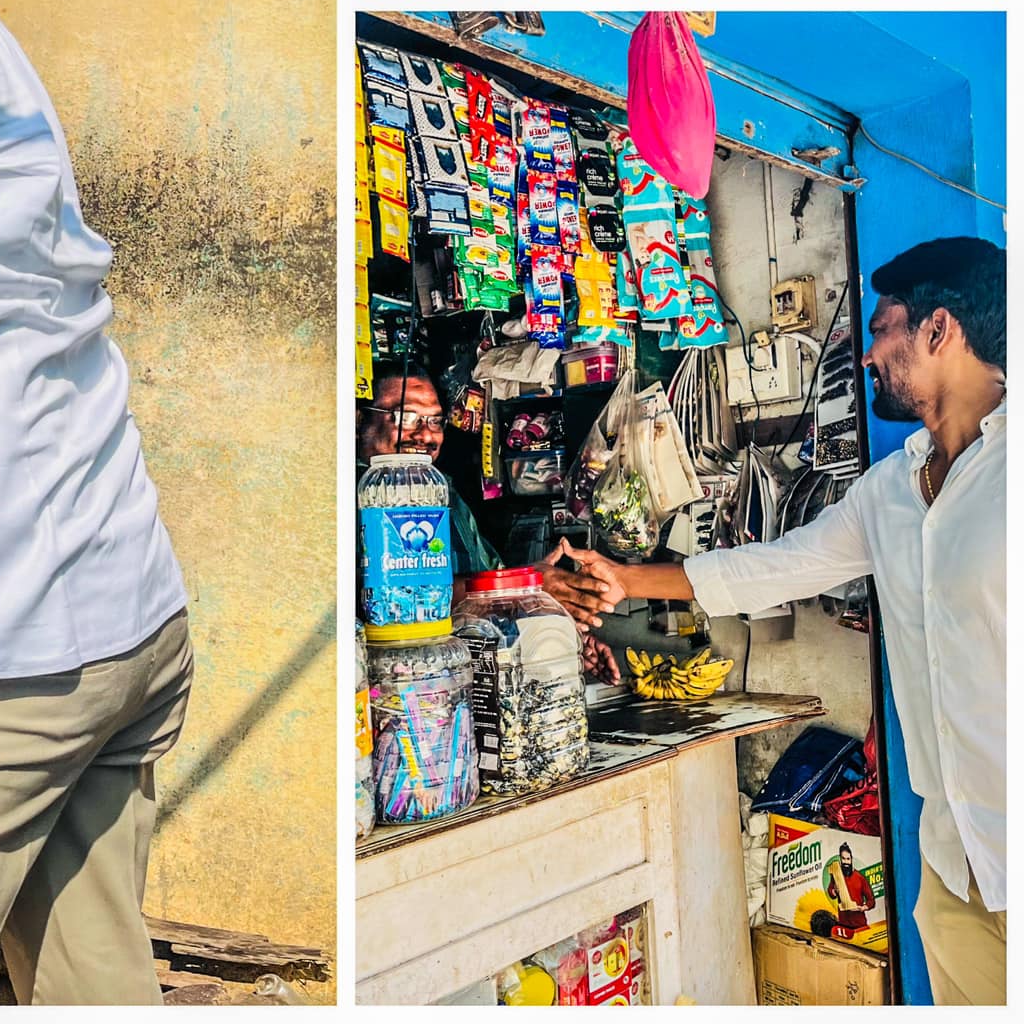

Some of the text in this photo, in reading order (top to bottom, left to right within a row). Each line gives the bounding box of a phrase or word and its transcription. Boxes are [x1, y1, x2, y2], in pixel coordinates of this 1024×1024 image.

[382, 552, 448, 570] Center fresh
[772, 840, 822, 878] Freedom
